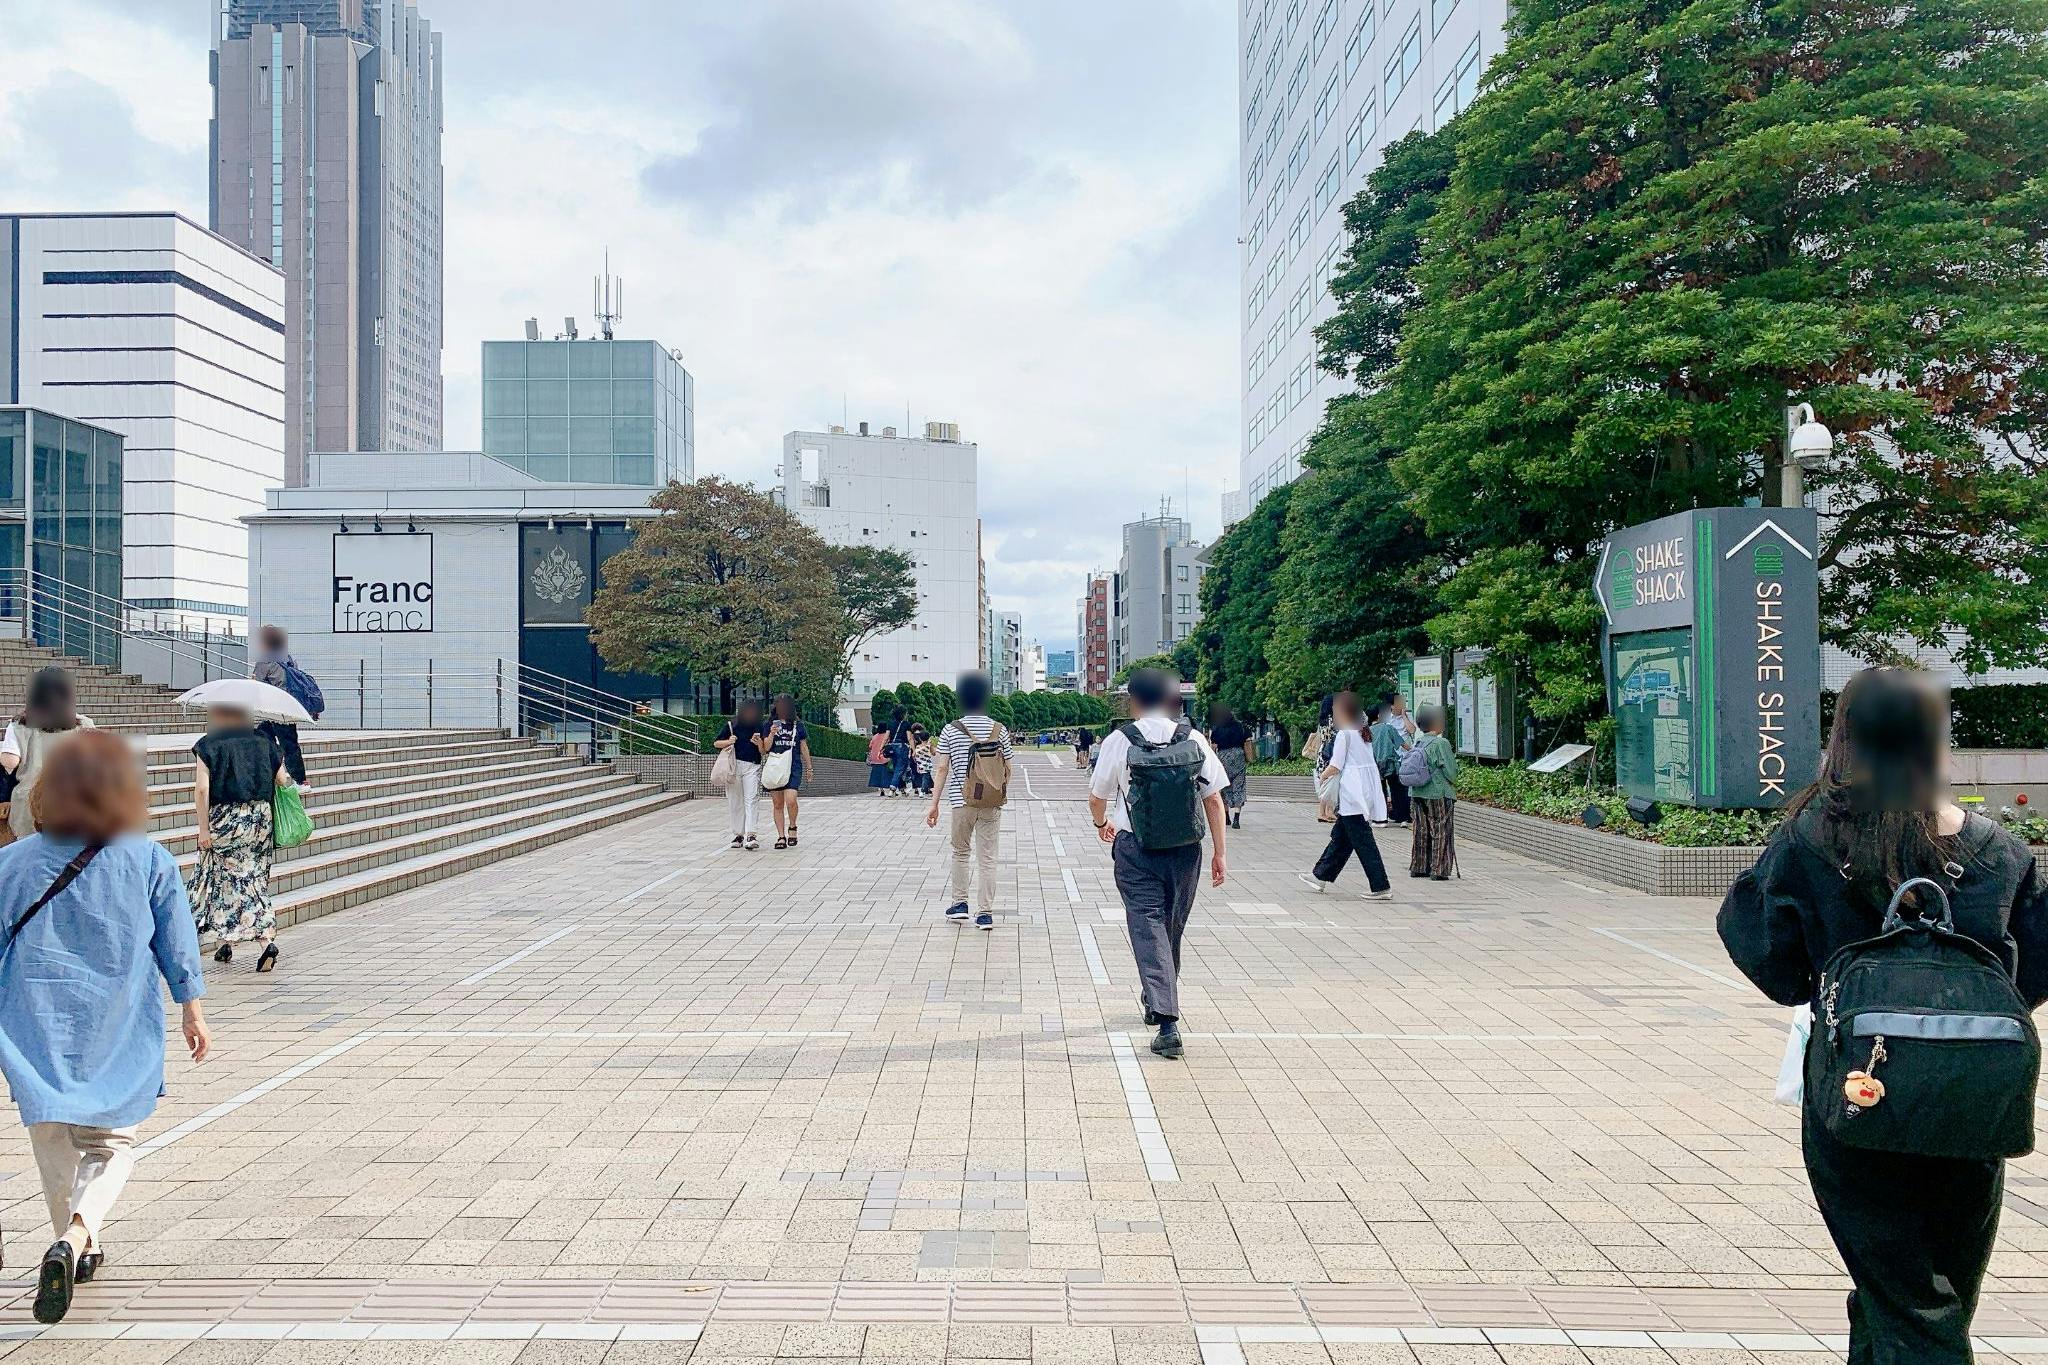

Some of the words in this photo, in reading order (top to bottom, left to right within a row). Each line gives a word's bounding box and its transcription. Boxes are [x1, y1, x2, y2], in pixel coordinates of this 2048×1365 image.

[1636, 537, 1684, 574] SHAKE
[333, 576, 432, 603] Franc
[1636, 570, 1686, 606] SHACK
[343, 604, 422, 631] franc
[1756, 581, 1784, 682] SHAKE
[1758, 692, 1786, 797] SHACK
